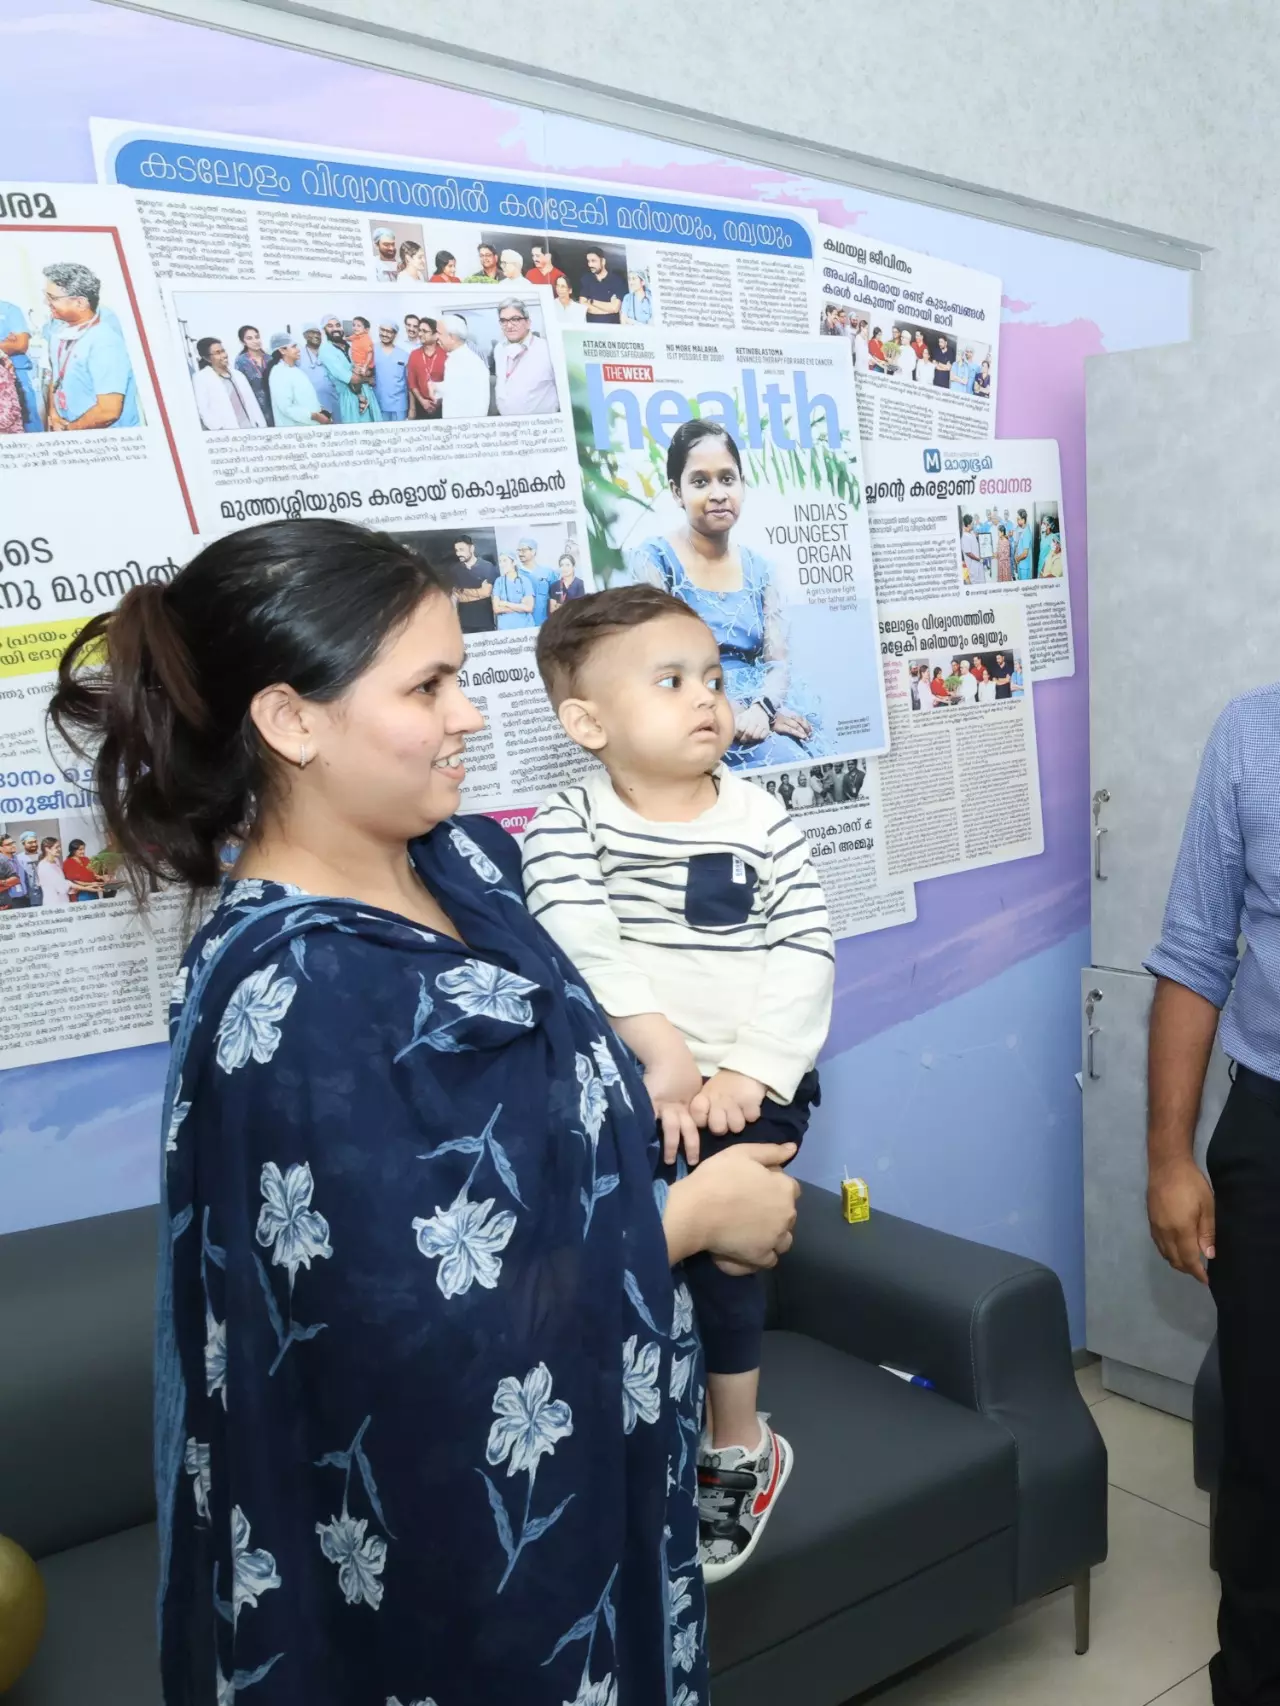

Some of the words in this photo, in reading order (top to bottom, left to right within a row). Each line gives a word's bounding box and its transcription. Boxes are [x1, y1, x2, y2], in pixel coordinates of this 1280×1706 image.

[140, 152, 290, 197] കടലോളം
[302, 163, 489, 214] വിശ്വാസത്തിൽ
[499, 193, 608, 228] കരളേകി
[616, 202, 717, 241] മരിയയും,
[723, 220, 792, 249] രമ്യയും
[823, 238, 867, 265] കഥയല്ല
[869, 250, 912, 274] ജീവിതം
[822, 266, 900, 297] അപരിചിതരായ
[902, 289, 925, 304] രണ്ട്
[822, 283, 851, 301] കരൾ
[585, 363, 842, 450] health
[926, 453, 939, 470] M
[369, 478, 447, 507] കരളായ്
[451, 469, 566, 500] കൊച്ചുമകൻ
[865, 478, 904, 503] ച്ഛന്റെ
[910, 475, 977, 499] കരളാണ്
[979, 477, 1032, 495] ദേവനന്ദ
[794, 503, 848, 522] INDIA'S
[765, 524, 849, 545] YOUNGEST
[797, 544, 852, 565] ORGAN
[799, 565, 854, 585] DONOR
[879, 619, 920, 637] ടലോളം
[922, 608, 995, 632] വിശ്വാസത്തിൽ
[880, 634, 918, 657] രളേകി
[920, 633, 969, 651] മരിയയും
[971, 631, 1008, 649] രമ്യയും
[472, 666, 535, 687] മരിയയും
[801, 817, 862, 839] സുകാരന്
